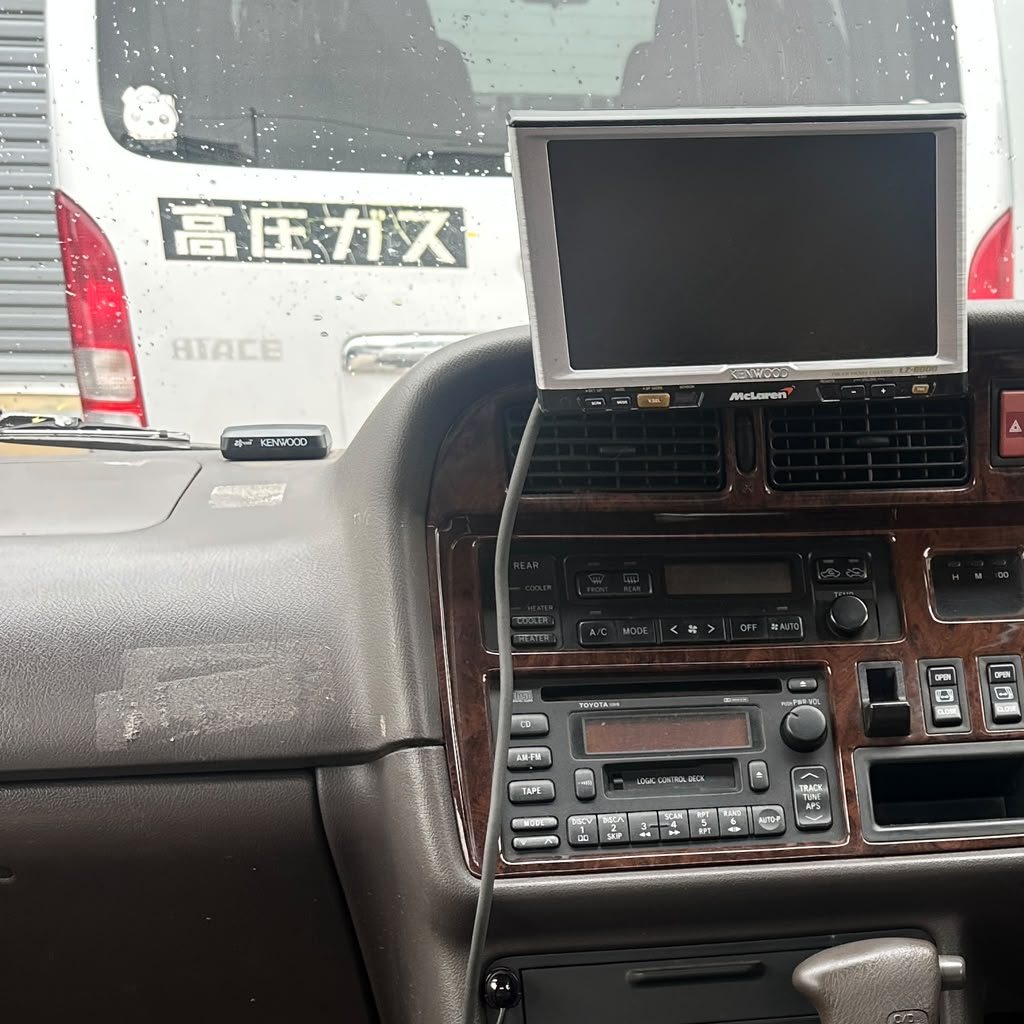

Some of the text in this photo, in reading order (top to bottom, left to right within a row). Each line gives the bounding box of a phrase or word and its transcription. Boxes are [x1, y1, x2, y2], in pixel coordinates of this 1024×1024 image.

[171, 204, 456, 264] 高圧ガス
[730, 367, 790, 379] KENWOOD
[729, 391, 787, 401] McLaren
[260, 438, 308, 447] KENWOOD
[513, 562, 539, 570] REAR
[740, 624, 757, 632] OFF
[780, 622, 800, 631] AUTO
[589, 628, 607, 636] A/C
[623, 627, 648, 635] MODE
[637, 775, 705, 785] LOGIC CONTROL DECK
[522, 787, 542, 795] TAPE
[806, 802, 820, 810] APS
[670, 820, 677, 828] 4
[701, 819, 707, 827] 5
[730, 817, 736, 825] 6
[758, 816, 781, 824] AUTO-P
[611, 824, 617, 832] 2
